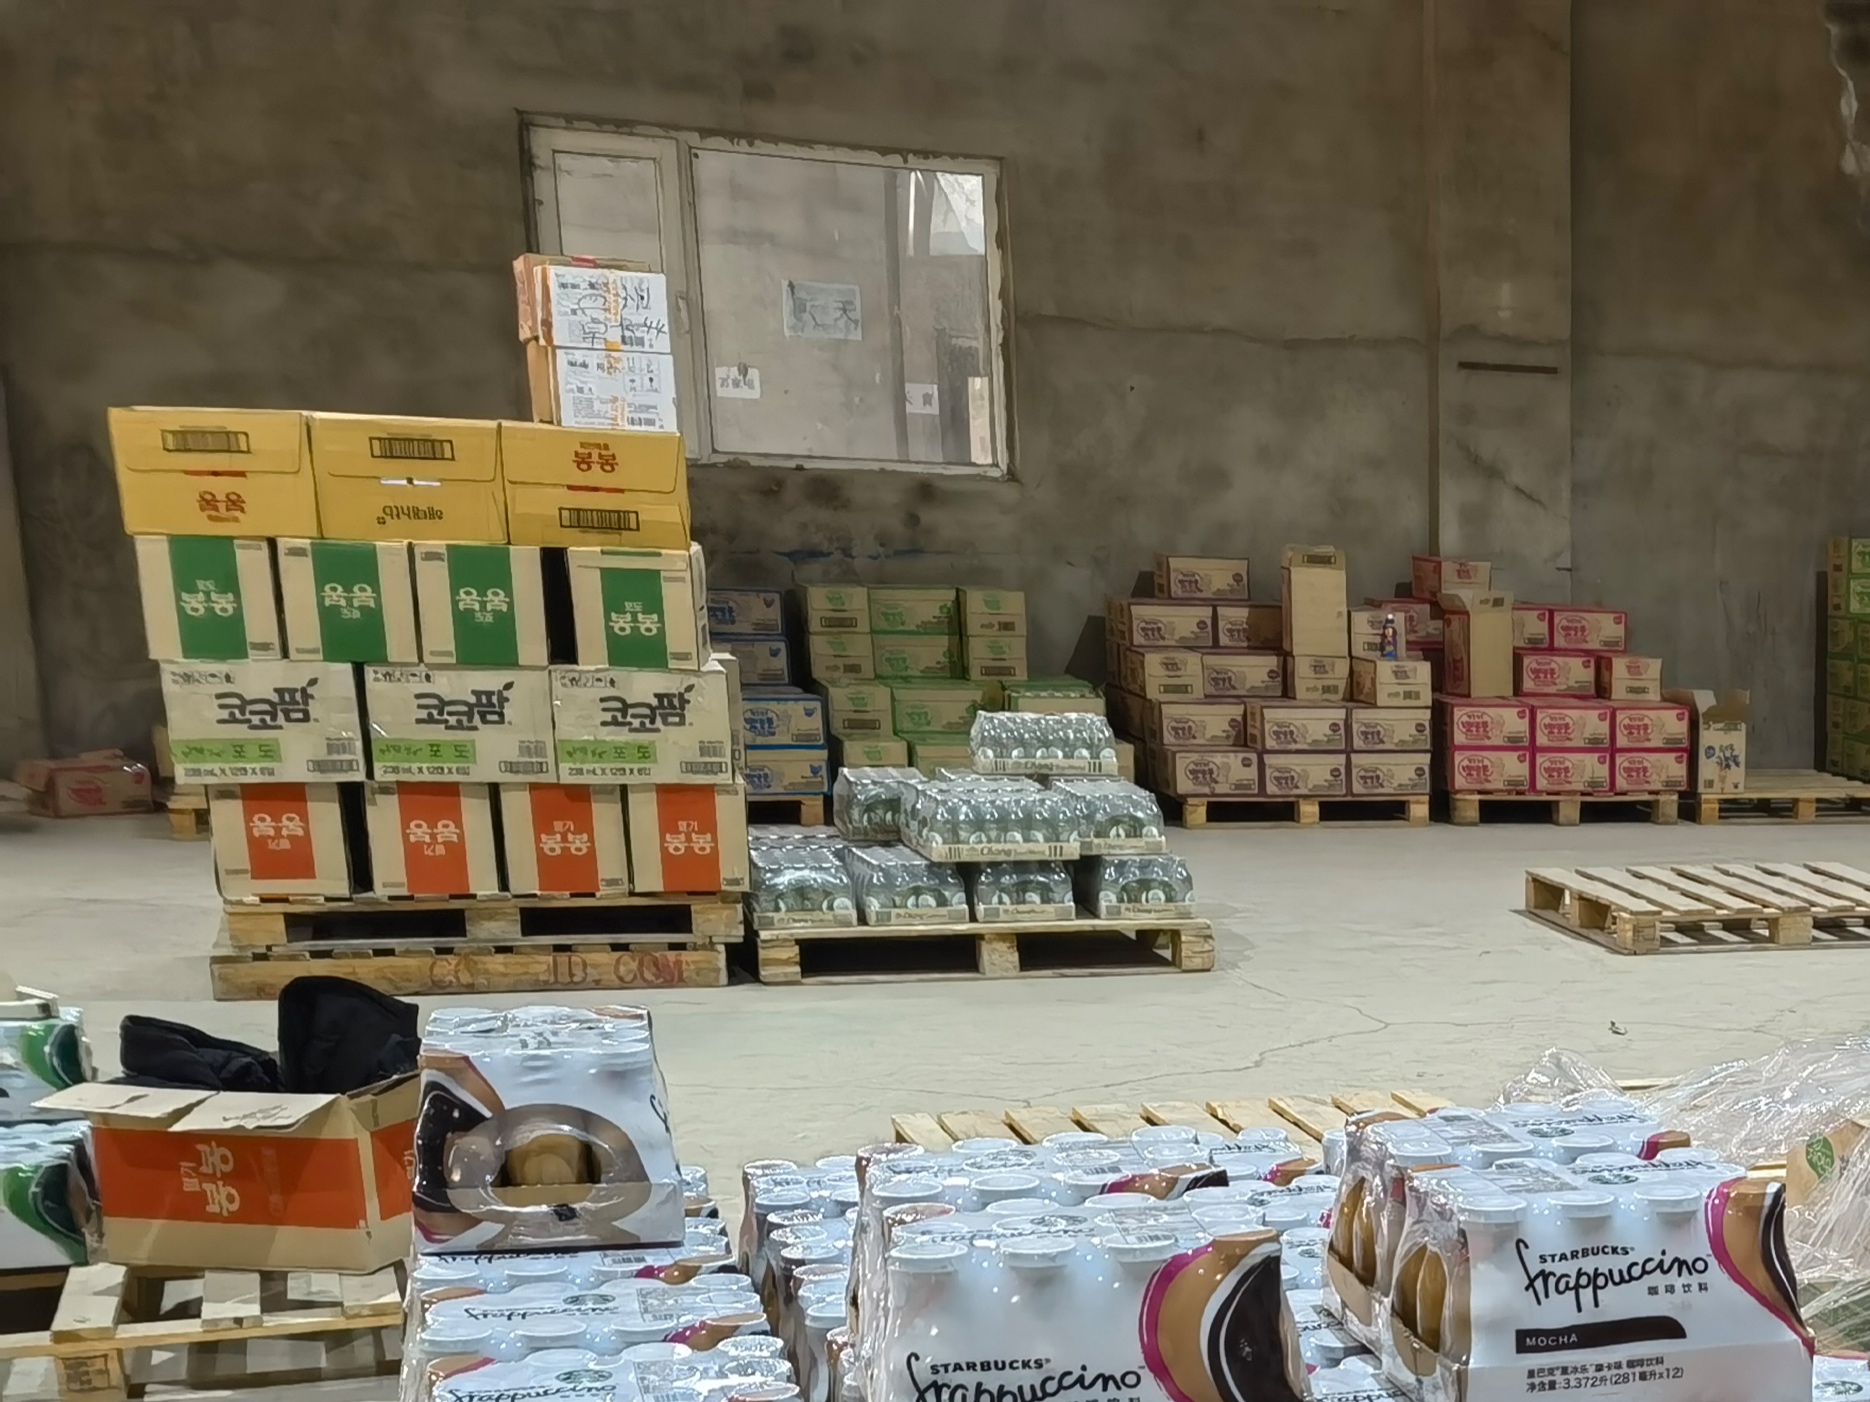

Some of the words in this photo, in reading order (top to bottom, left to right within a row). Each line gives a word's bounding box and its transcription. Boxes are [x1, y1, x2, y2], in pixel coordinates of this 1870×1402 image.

[179, 591, 237, 617] 봉봉
[320, 583, 376, 608] 봉봉
[456, 587, 510, 612] 봉봉
[609, 612, 661, 636] 봉봉
[214, 685, 315, 730] 코코팜
[414, 689, 510, 731] 코코팜
[599, 691, 691, 732] 코코팜
[539, 833, 591, 856] 봉봉
[664, 832, 715, 855] 봉봉
[198, 1140, 240, 1217] 봉봉
[1515, 1237, 1709, 1313] frappuccino
[1525, 1333, 1579, 1347] MOCHA
